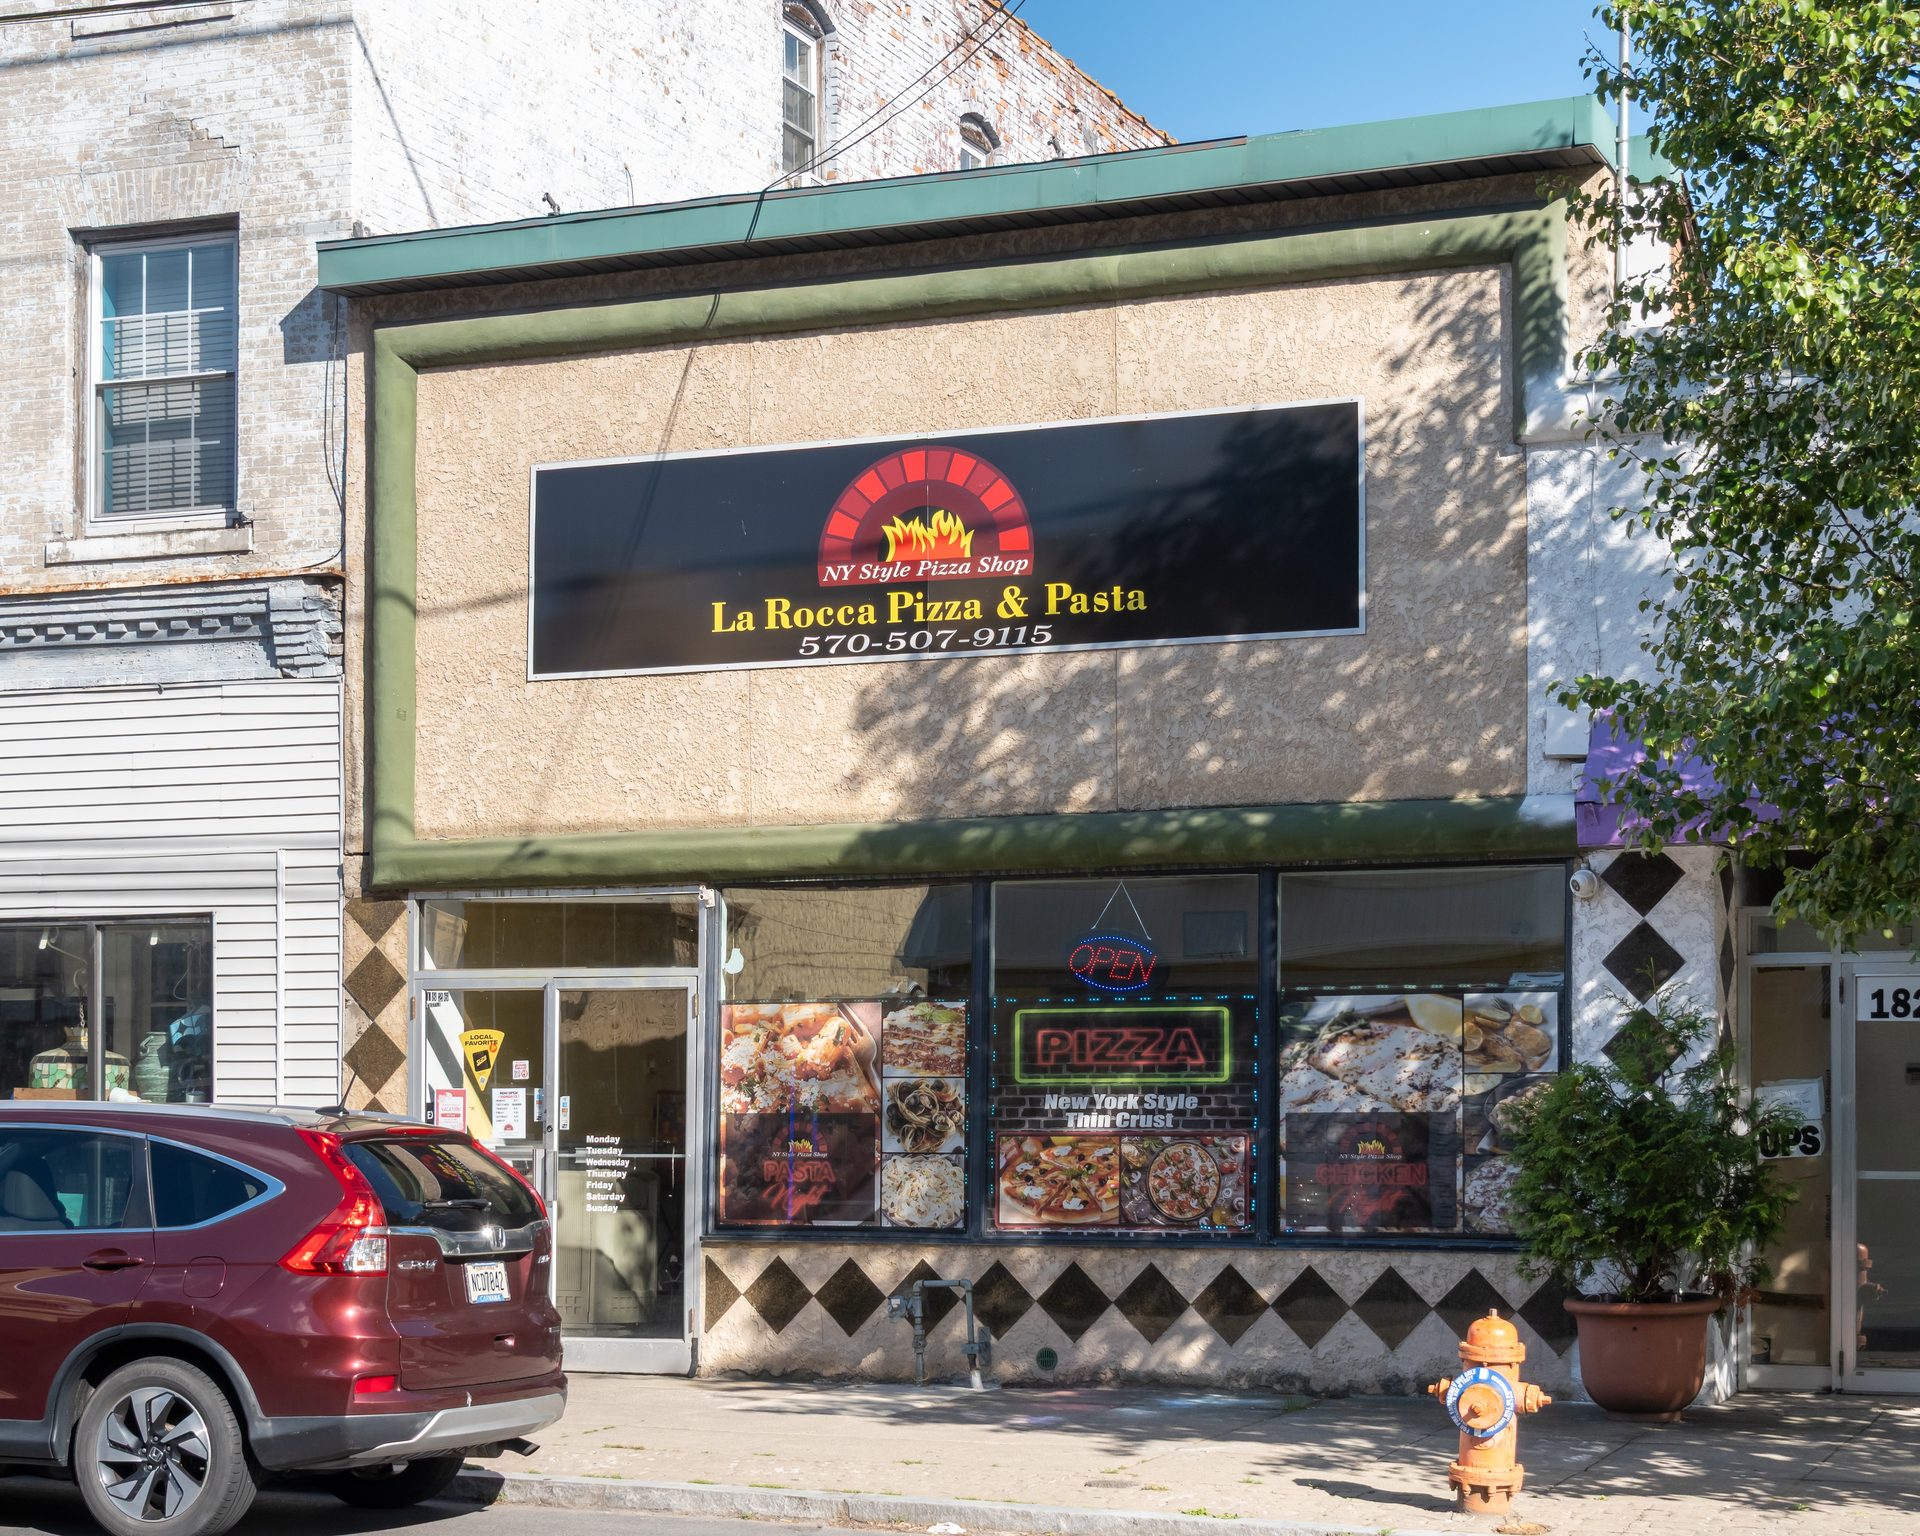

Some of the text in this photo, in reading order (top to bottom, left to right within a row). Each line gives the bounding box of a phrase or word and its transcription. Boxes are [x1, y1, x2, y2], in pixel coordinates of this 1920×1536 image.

[822, 556, 1029, 582] NY Style Pizza Shop
[711, 582, 1148, 633] La Rocca Pizza & Pasta
[798, 624, 1053, 656] 570-507-9115
[1069, 944, 1158, 983] OPEN
[1037, 1028, 1205, 1065] PIZZA
[1044, 1094, 1199, 1111] New York Style
[1066, 1112, 1174, 1128] Thin Crust
[586, 1135, 620, 1144] Monday
[586, 1147, 623, 1155] Tuesday
[586, 1158, 630, 1168] Wednesday
[586, 1170, 627, 1179] Thursday
[763, 1161, 836, 1182] PASTA
[1316, 1163, 1427, 1185] CHICKEN
[586, 1181, 613, 1190] Friday
[586, 1193, 625, 1202] Saturday
[586, 1204, 618, 1213] Sunday
